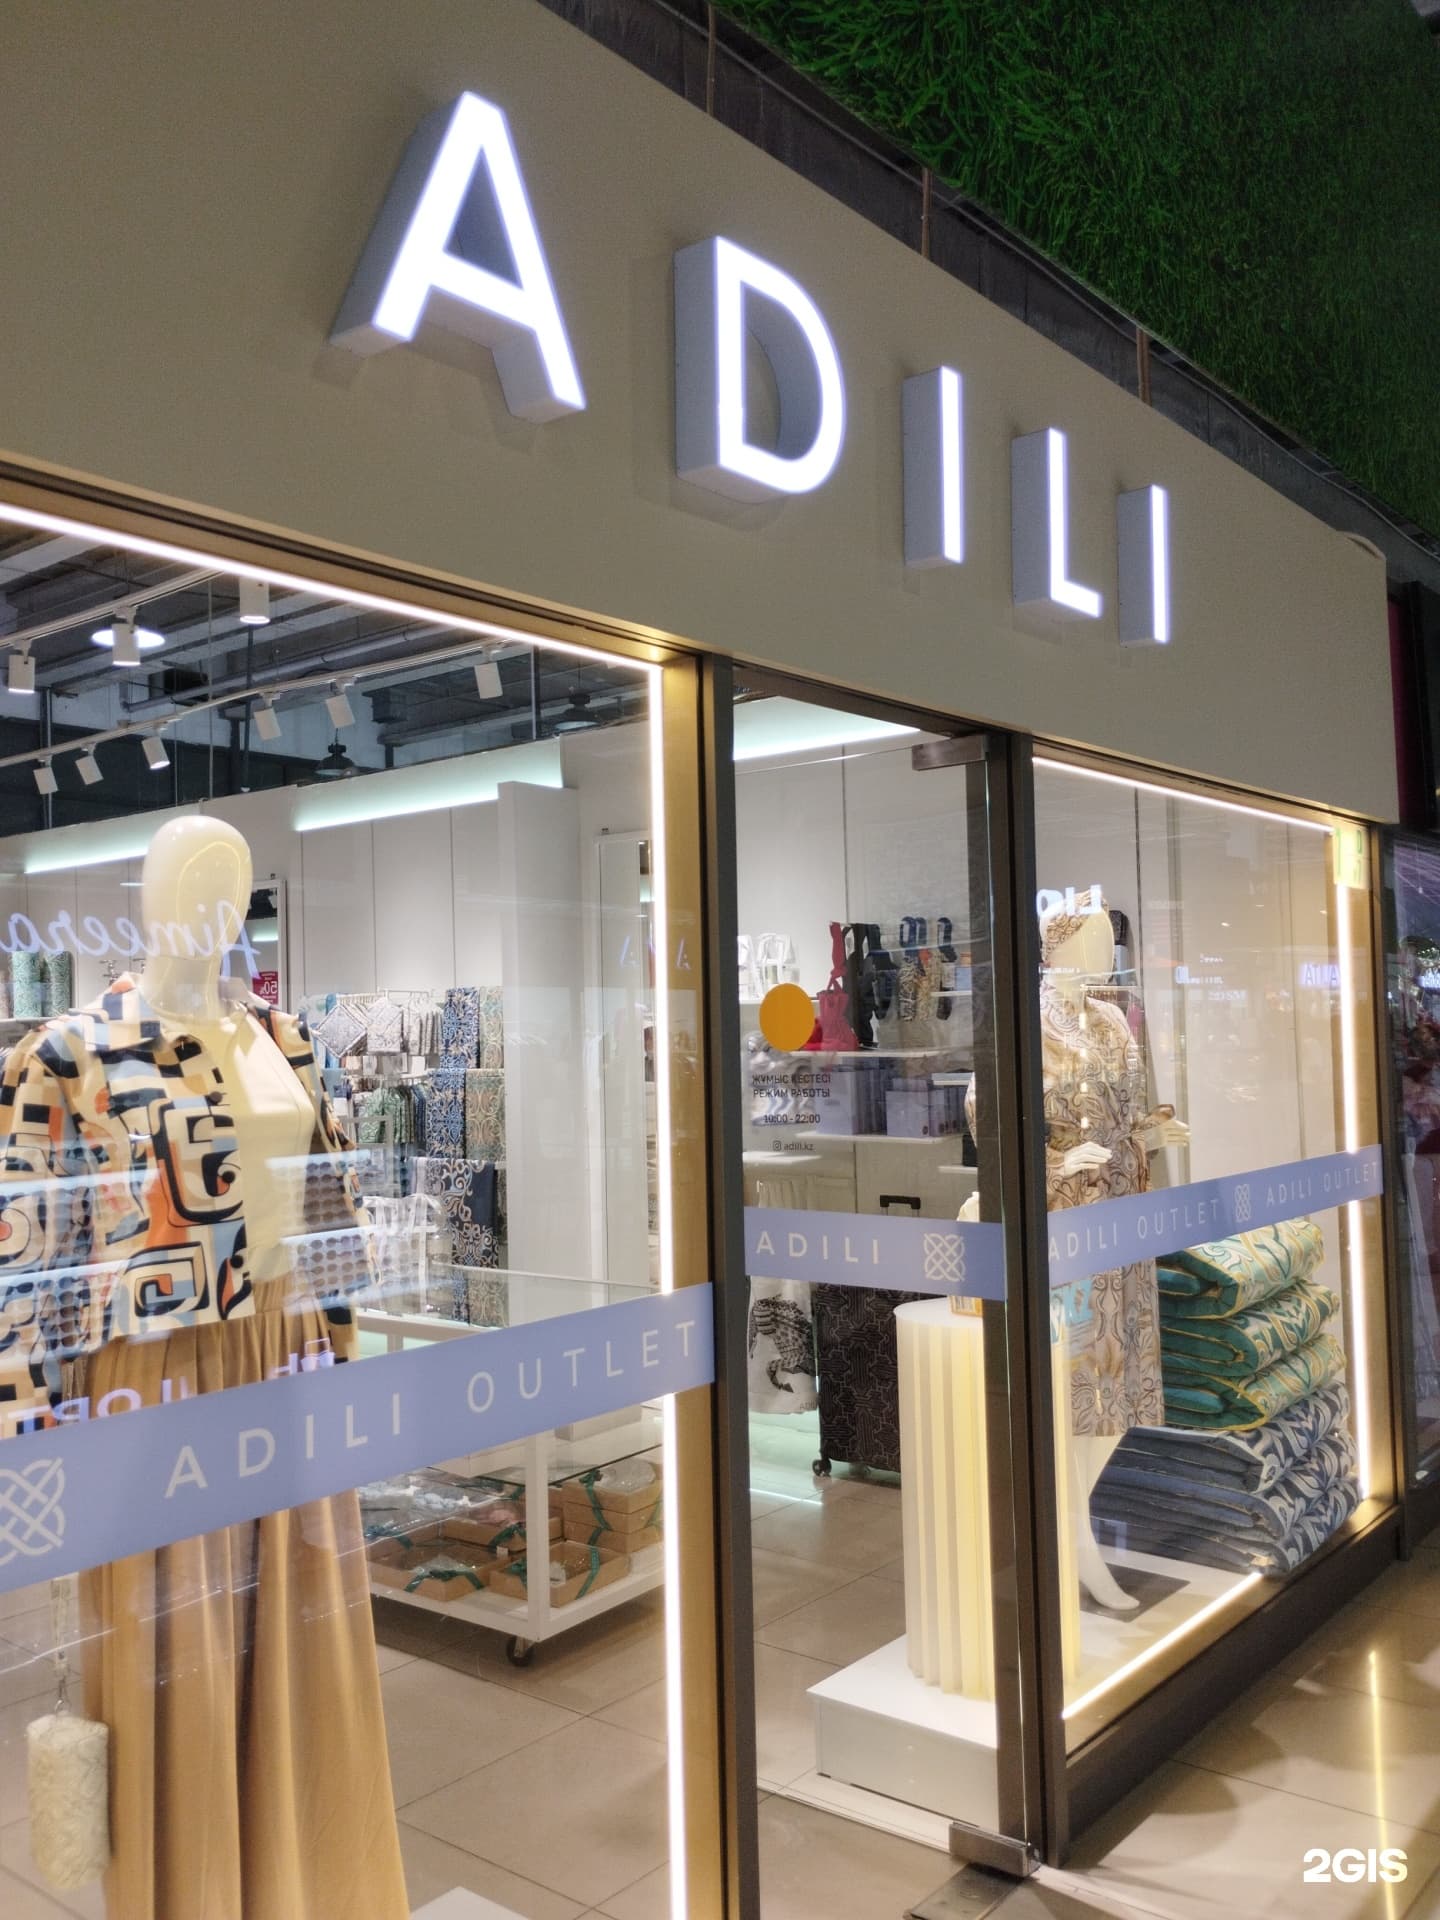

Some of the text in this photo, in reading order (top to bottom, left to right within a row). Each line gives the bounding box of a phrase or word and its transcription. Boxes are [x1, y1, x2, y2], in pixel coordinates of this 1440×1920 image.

[372, 89, 1170, 645] ADILI
[753, 1088, 830, 1098] РЕЖИМ РАБОТЫ
[764, 1114, 788, 1124] 10:00
[796, 1114, 820, 1124] 22:00
[1266, 1161, 1378, 1207] ADILI OUTLET
[756, 1231, 880, 1265] ADILI
[1048, 1198, 1219, 1262] ADILI OUTLET
[164, 1320, 699, 1498] ADILI OUTLET
